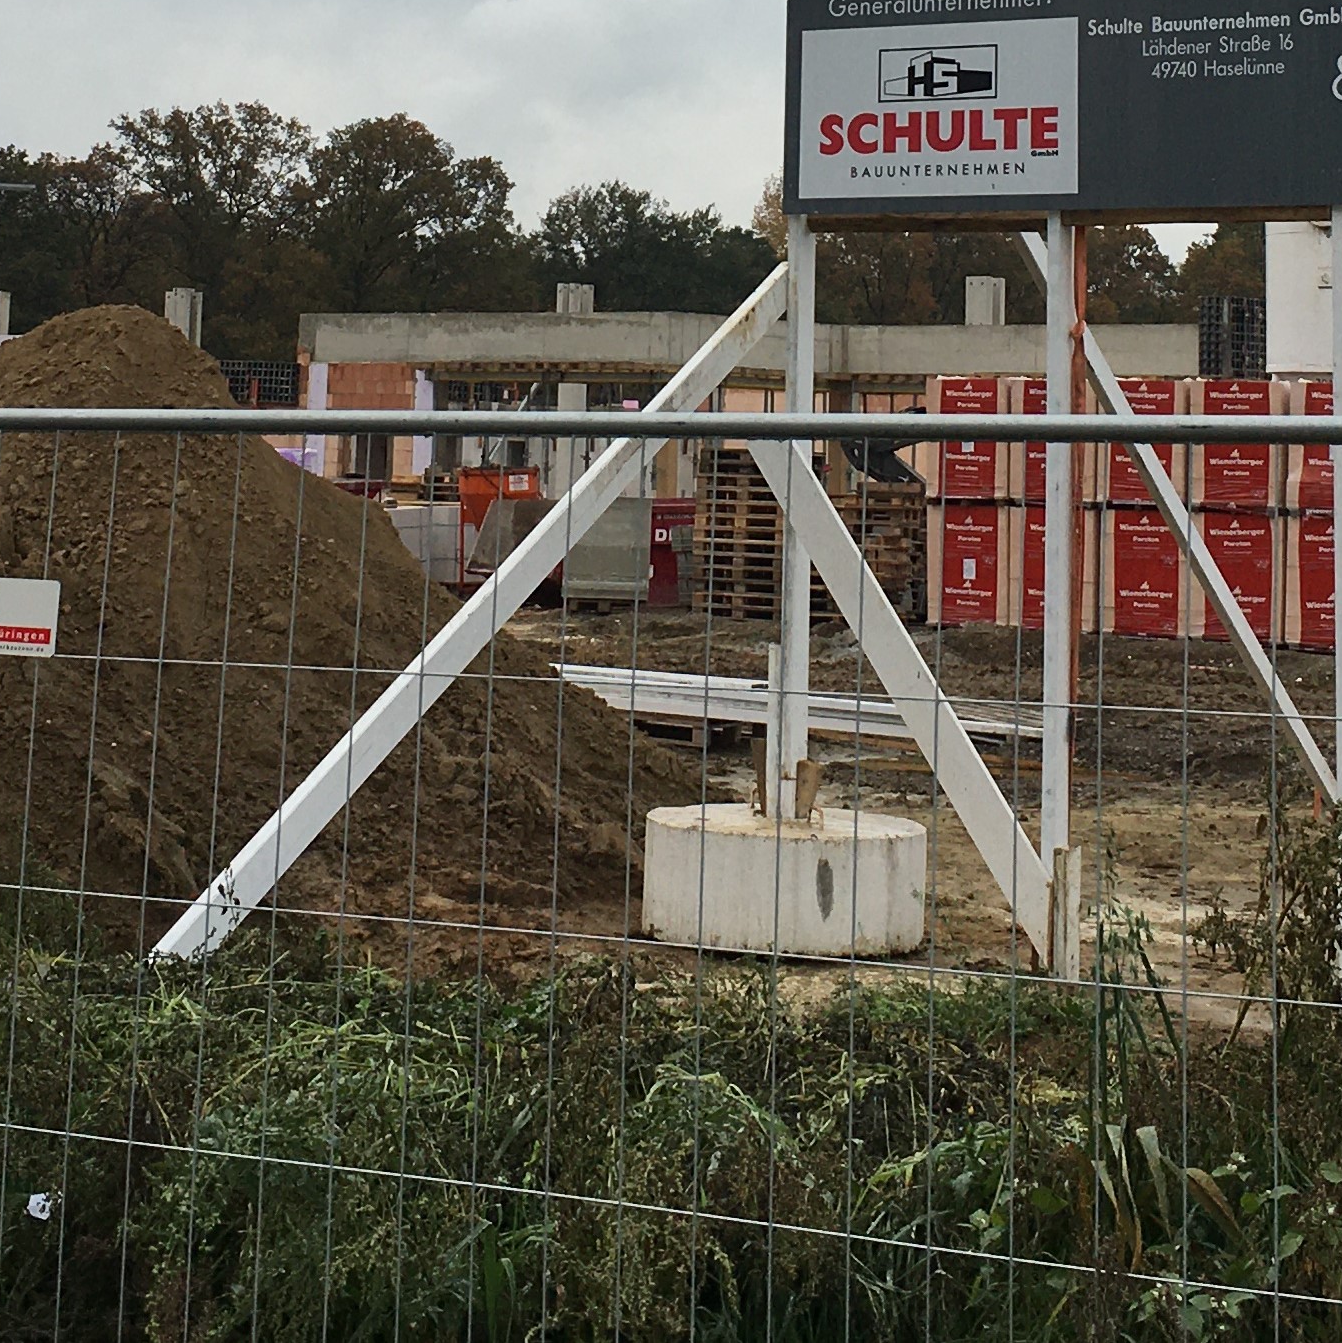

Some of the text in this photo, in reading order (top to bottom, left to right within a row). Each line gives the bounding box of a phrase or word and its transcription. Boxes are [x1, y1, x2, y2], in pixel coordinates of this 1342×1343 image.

[1087, 18, 1143, 37] Schulte
[1152, 12, 1291, 33] Bauunternehmen
[1219, 34, 1272, 54] Straße
[1278, 33, 1294, 51] 16
[1152, 57, 1285, 79] 49740 Haselünne
[819, 106, 1059, 156] SCHULTE
[850, 162, 1026, 178] BAUUNTERNEHMEN
